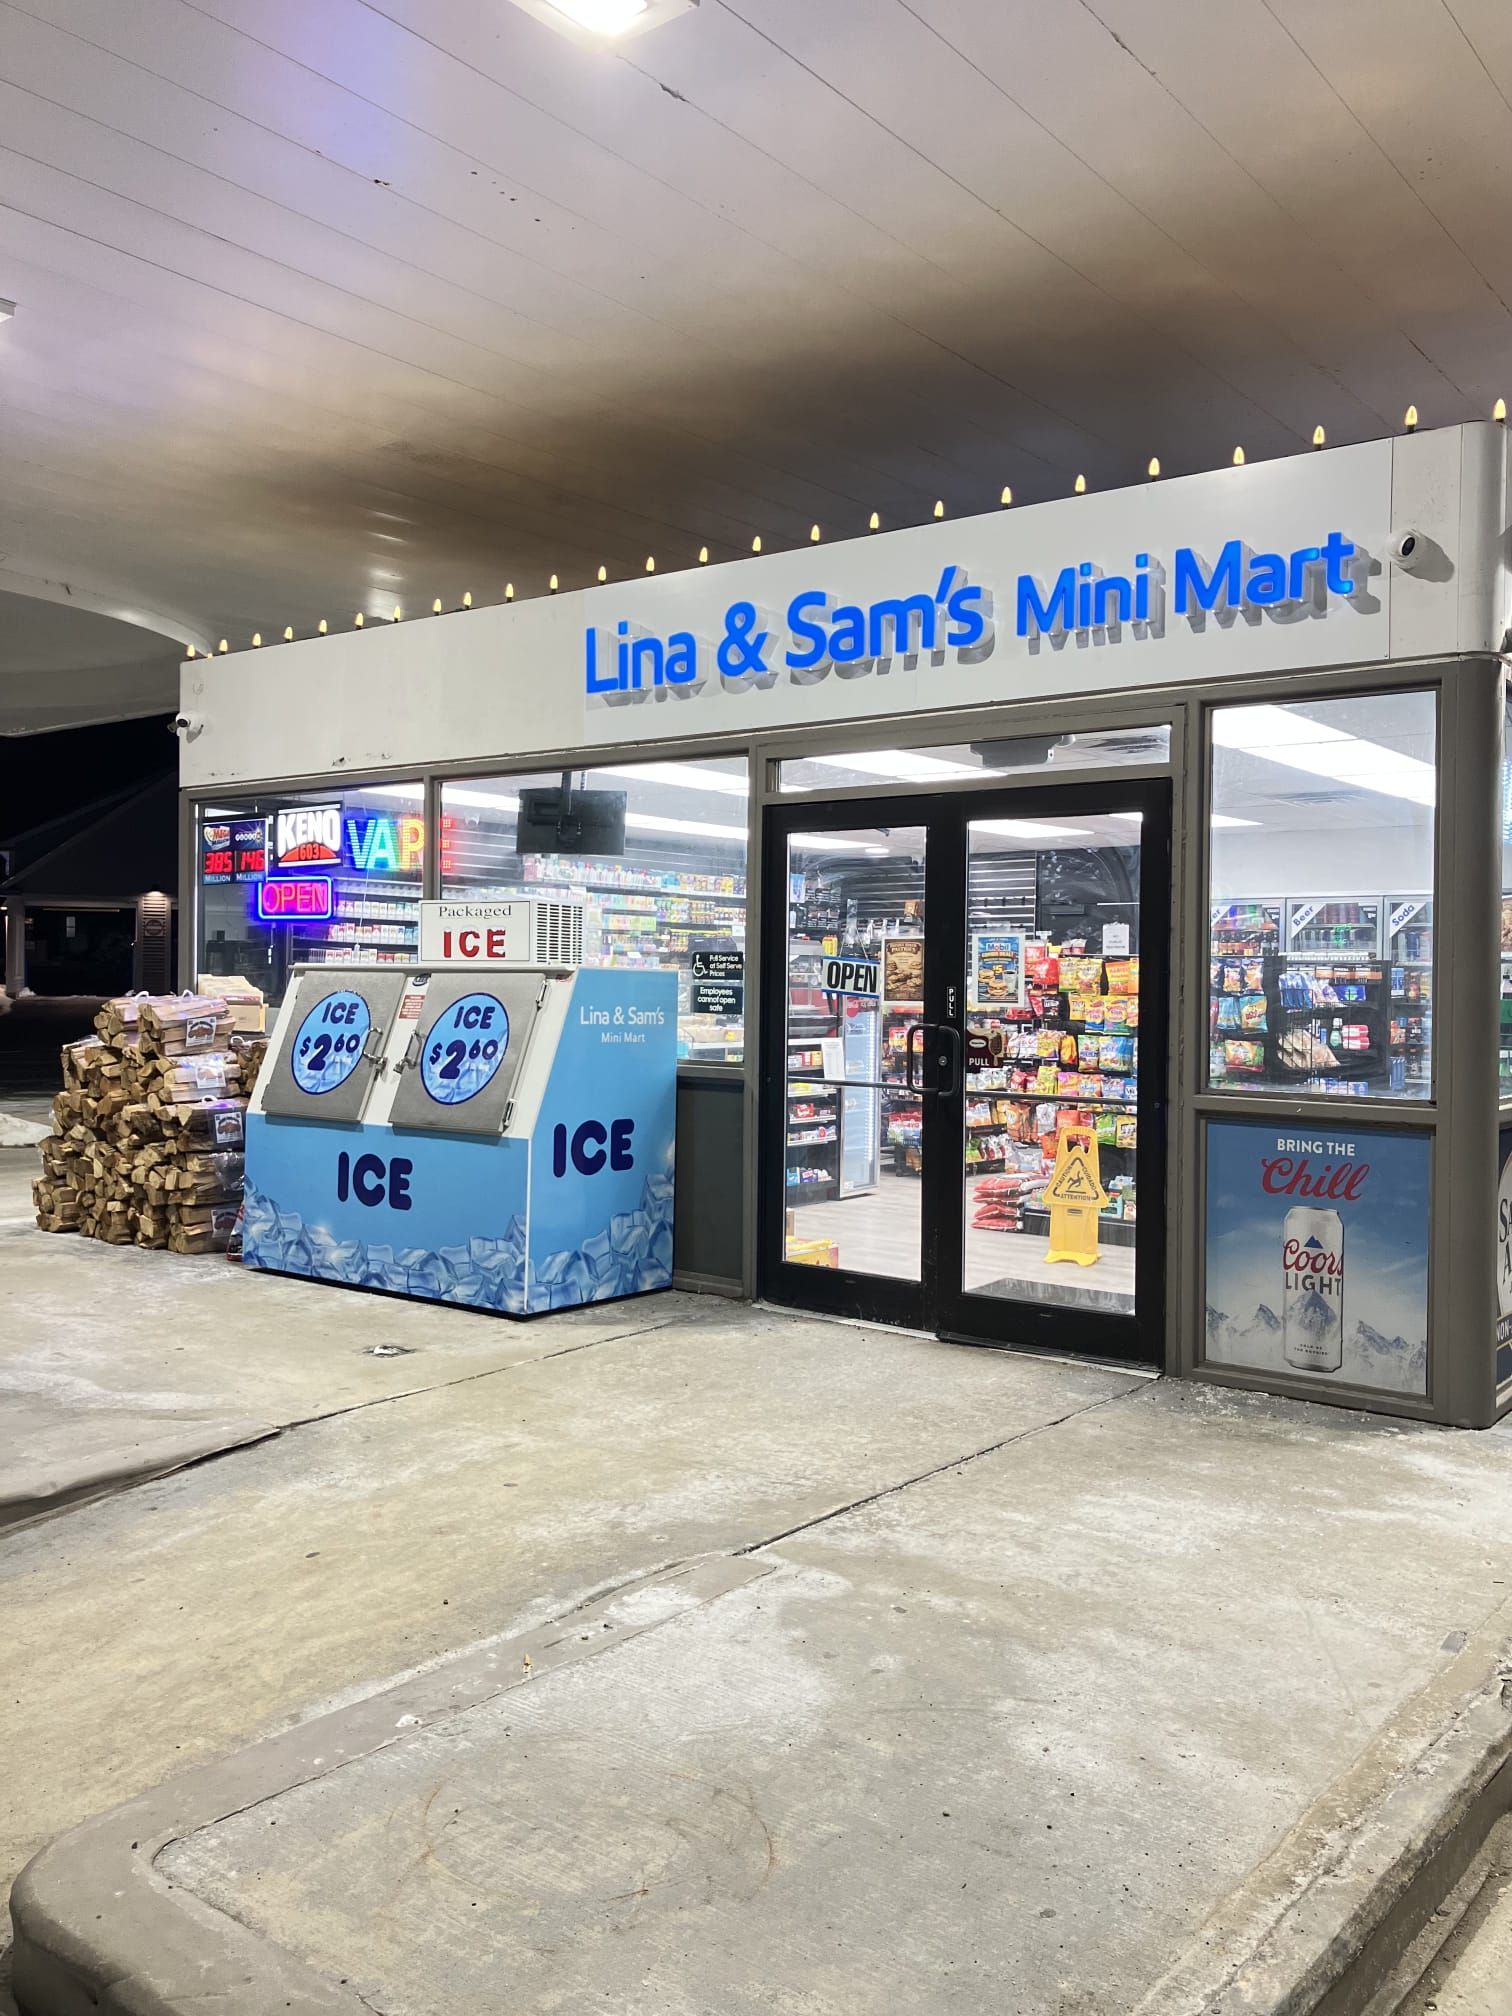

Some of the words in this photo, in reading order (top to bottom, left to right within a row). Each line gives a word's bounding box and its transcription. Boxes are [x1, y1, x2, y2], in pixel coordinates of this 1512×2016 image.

[586, 620, 696, 694] Lina
[717, 601, 769, 677] &
[785, 565, 983, 668] Sam's
[1016, 552, 1149, 637] Mini
[1174, 532, 1355, 614] Mart
[277, 809, 341, 858] KENO
[347, 818, 451, 870] VAP
[300, 844, 321, 860] 603
[236, 872, 264, 881] MILLION
[262, 882, 328, 913] OPEN
[439, 905, 512, 919] Packaged
[1294, 904, 1315, 927] Beer
[1391, 904, 1416, 926] Soda
[443, 928, 506, 958] ICE
[827, 961, 877, 993] OPEN
[700, 986, 733, 996] Employees
[321, 1001, 359, 1025] ICE
[453, 1005, 496, 1029] ICE
[580, 1005, 610, 1025] Lina
[613, 1006, 625, 1025] &
[627, 1006, 665, 1025] Sam's
[601, 1031, 622, 1043] Mini
[624, 1032, 646, 1043] Mart
[968, 1057, 990, 1066] PULL
[553, 1118, 635, 1178] ICE
[1277, 1138, 1323, 1154] BRING
[1326, 1141, 1356, 1156] THE
[337, 1151, 413, 1211] ICE
[1056, 1166, 1073, 1187] CAUTION
[1261, 1157, 1370, 1201] Chill
[1285, 1271, 1341, 1296] LIGHT
